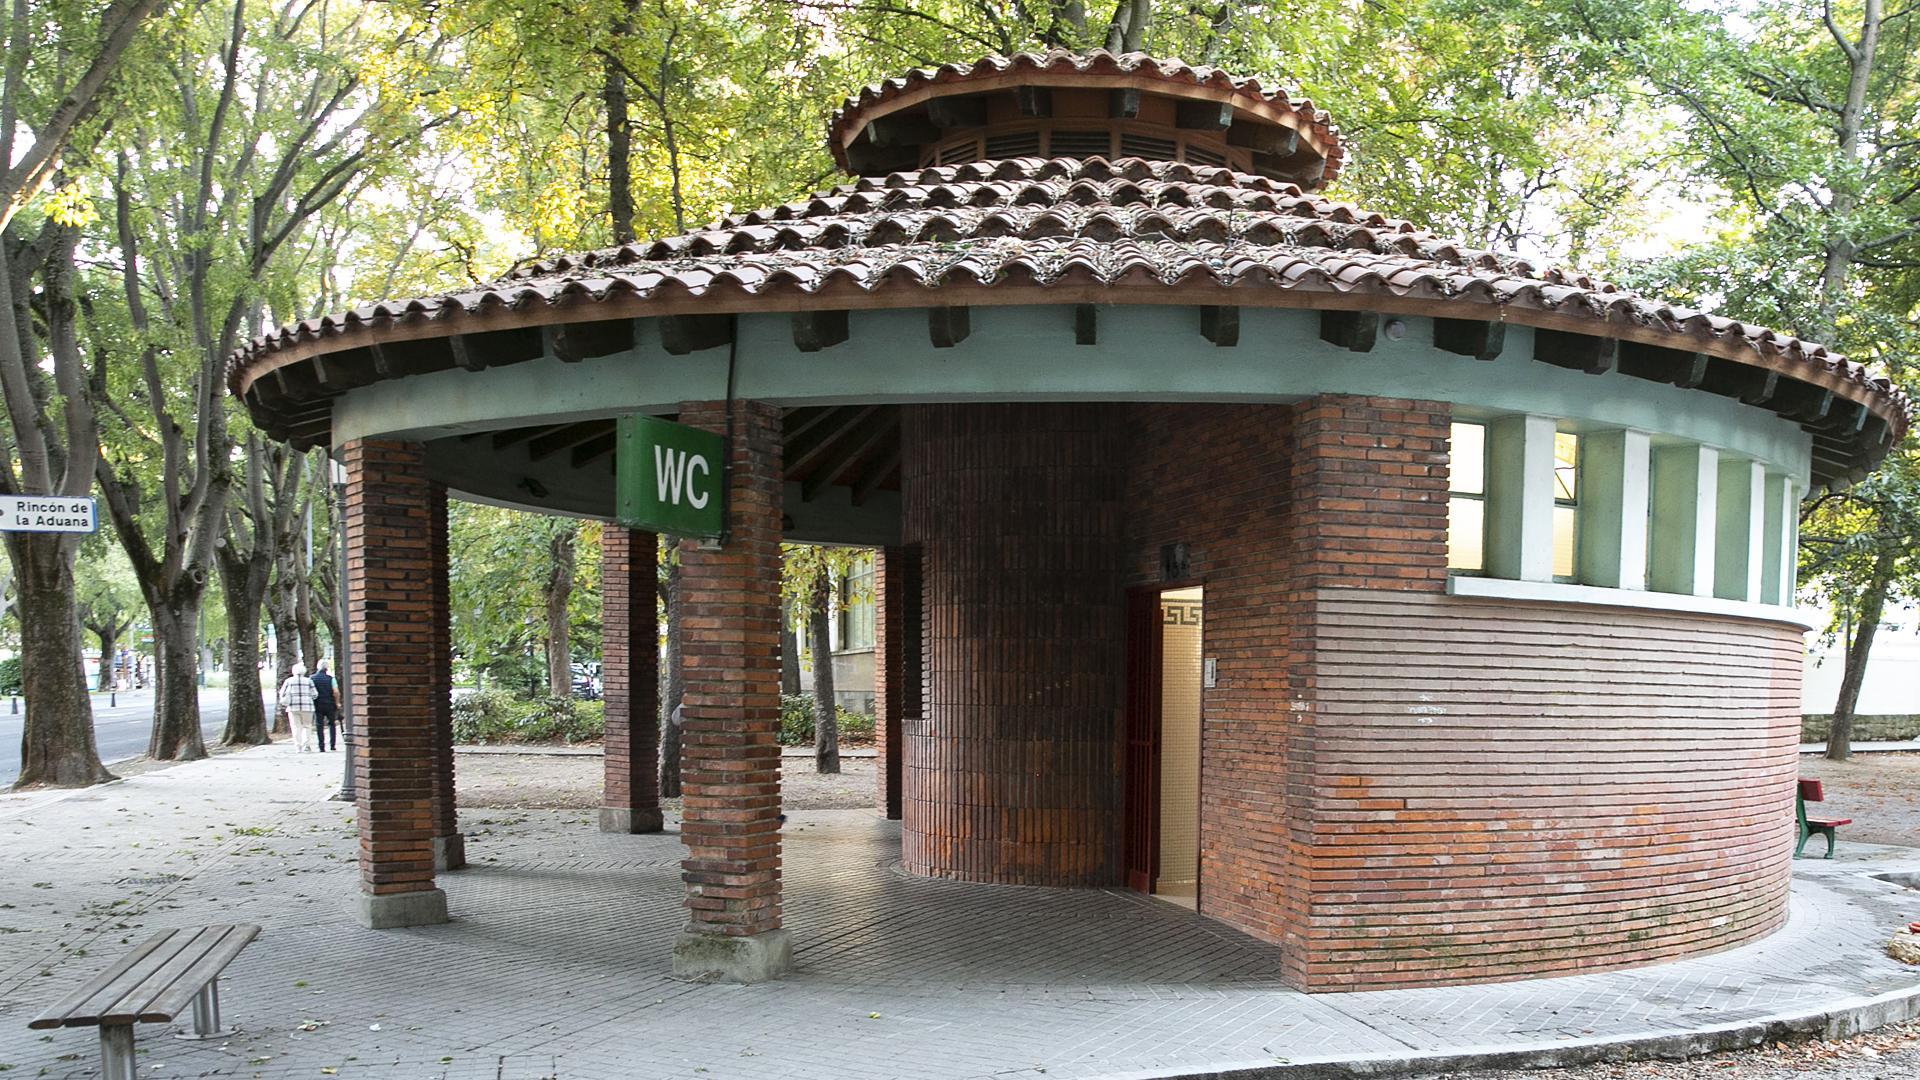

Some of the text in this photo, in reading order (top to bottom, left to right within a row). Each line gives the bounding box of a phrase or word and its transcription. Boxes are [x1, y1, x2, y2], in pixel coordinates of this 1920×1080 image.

[654, 444, 709, 509] WC
[17, 501, 88, 513] Rincón de
[16, 515, 88, 527] la Aduana
